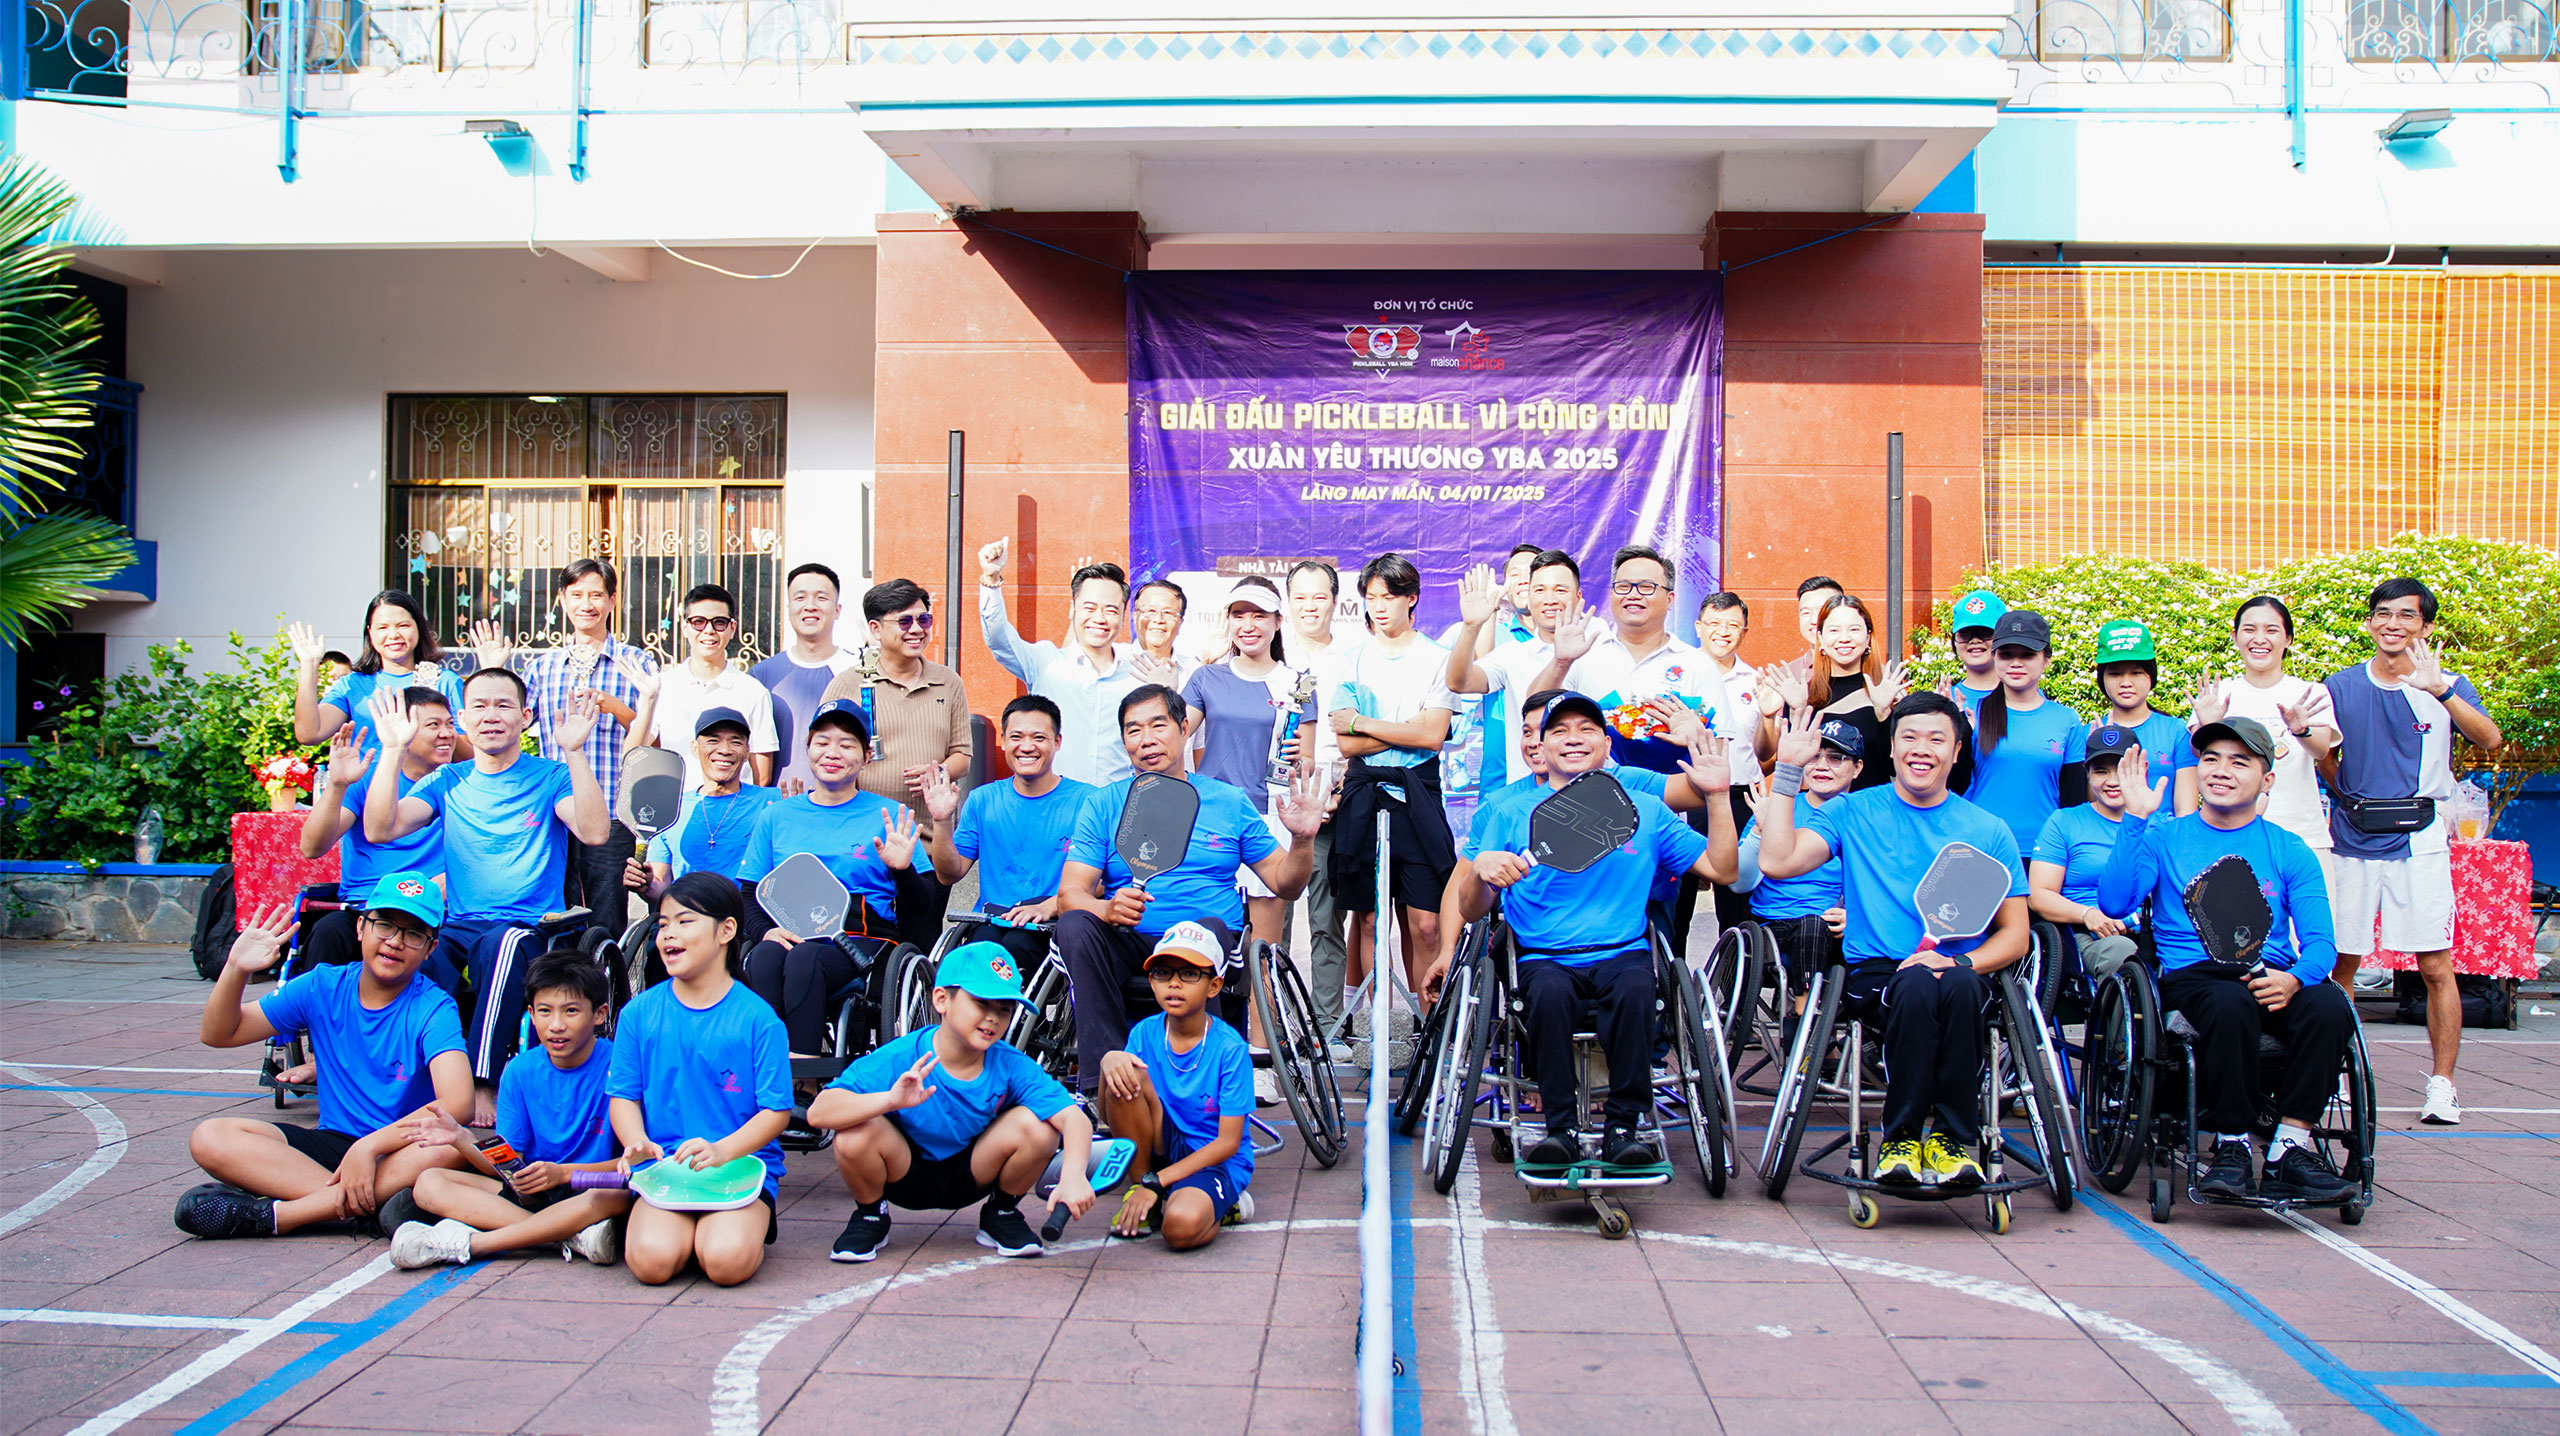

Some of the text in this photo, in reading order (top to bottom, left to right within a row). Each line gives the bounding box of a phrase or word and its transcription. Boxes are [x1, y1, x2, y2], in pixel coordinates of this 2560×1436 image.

[1373, 297, 1474, 312] ĐƠN VỊ TỔ CHỨC
[1430, 356, 1460, 367] maison
[1458, 355, 1505, 371] chance
[1159, 396, 1217, 431] GIẢI
[1224, 395, 1284, 431] ĐẤU
[1293, 402, 1470, 431] PICKLEBALL
[1478, 397, 1508, 431] VÌ
[1517, 398, 1598, 437] CỘNG
[1227, 441, 1619, 470] XUÂN YÊU THƯƠNG YBA 2025
[1301, 481, 1546, 503] LÀNG MAY MẮN, 04/01/2025
[1238, 559, 1265, 574] NHÀ
[1268, 559, 1289, 574] TÀI
[1116, 790, 1141, 846] Olympus
[1129, 856, 1158, 871] Olympus
[1918, 856, 1952, 900] Olympus
[814, 913, 840, 934] Olympus
[1927, 912, 1956, 933] Olympus
[2195, 904, 2223, 957] Olympus
[1178, 927, 1204, 941] VTB
[2235, 938, 2261, 959] Olympus
[1100, 1146, 1132, 1178] SLK
